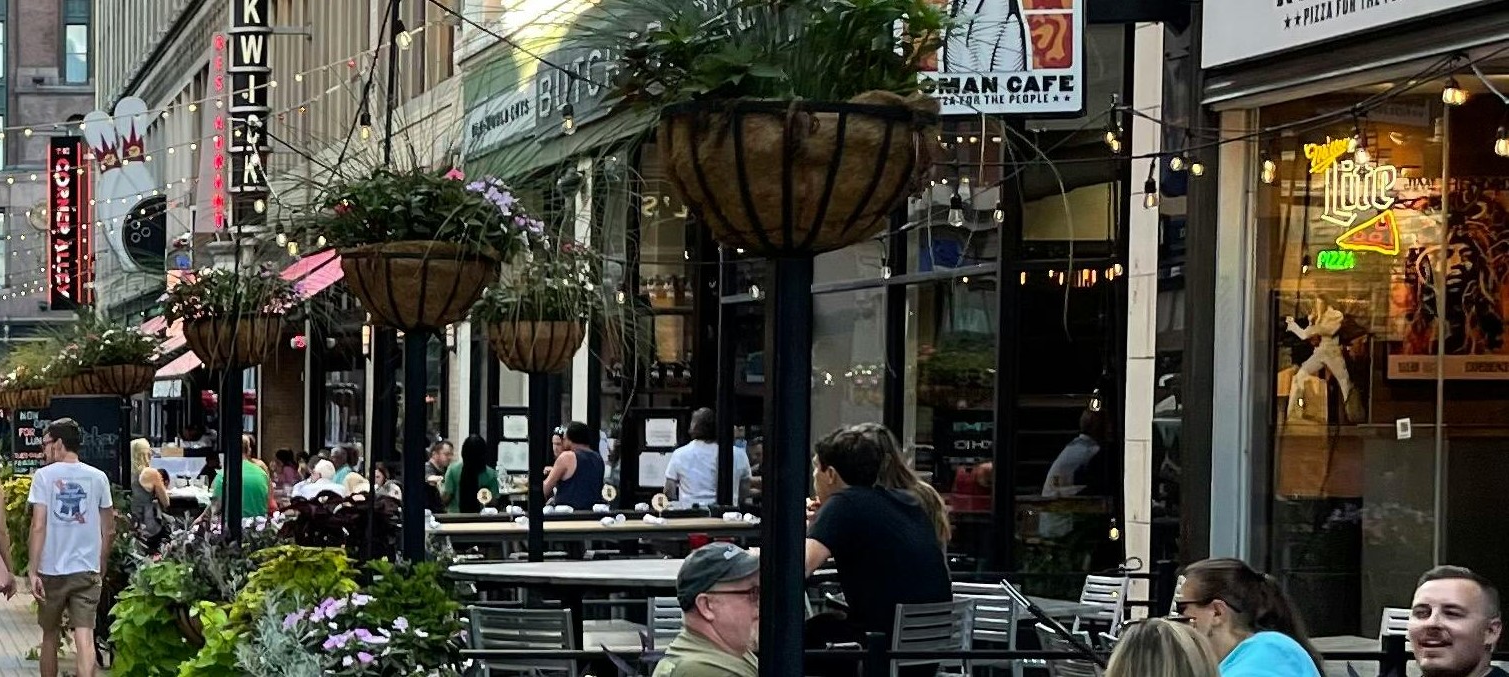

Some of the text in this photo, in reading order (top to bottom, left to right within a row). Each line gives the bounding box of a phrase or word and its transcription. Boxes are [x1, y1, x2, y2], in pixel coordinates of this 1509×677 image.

[1304, 1, 1333, 26] PIZZA
[1006, 75, 1074, 93] CAFE
[985, 94, 1005, 105] THE
[1009, 94, 1049, 104] PEOPLE
[1320, 159, 1398, 227] Lite
[54, 238, 71, 299] ALLEY
[1317, 250, 1356, 270] PIZZA
